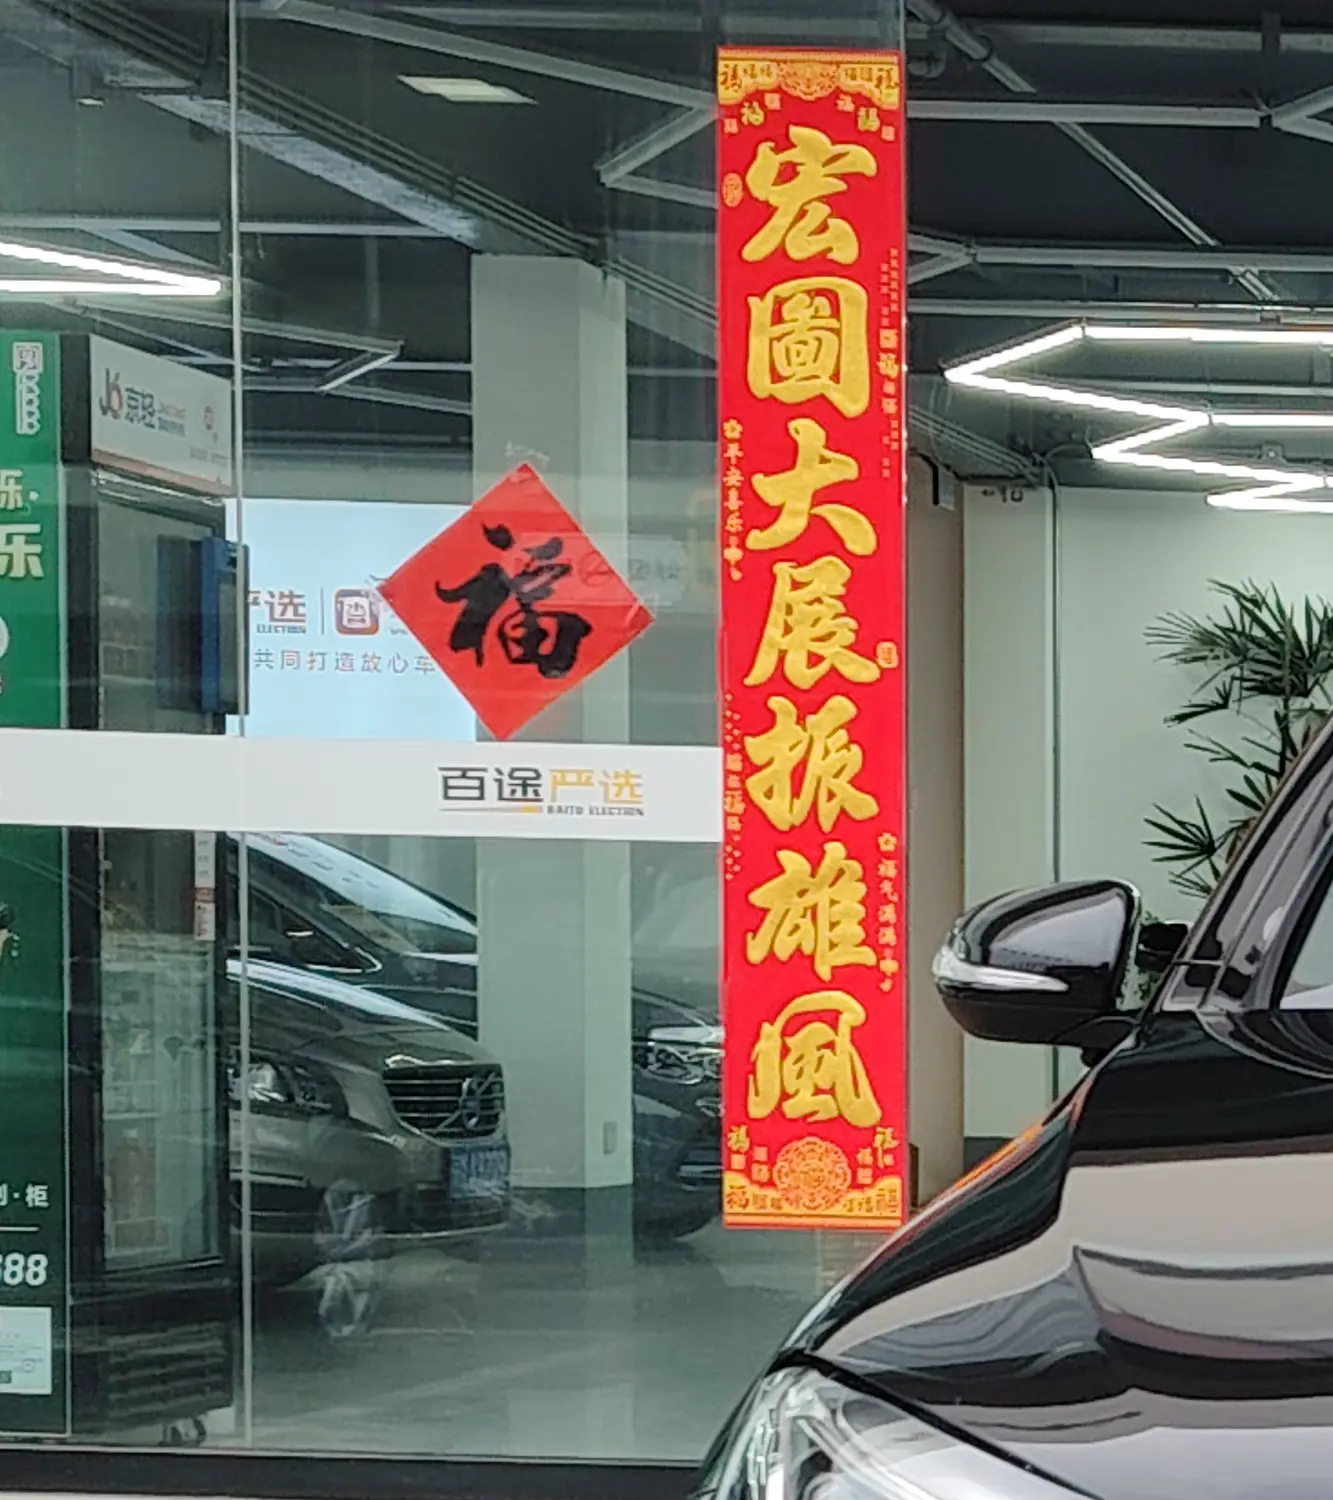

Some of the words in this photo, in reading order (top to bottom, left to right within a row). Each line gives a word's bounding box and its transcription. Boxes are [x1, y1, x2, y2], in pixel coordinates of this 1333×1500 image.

[435, 522, 592, 679] 福
[438, 767, 645, 804] 百途严选
